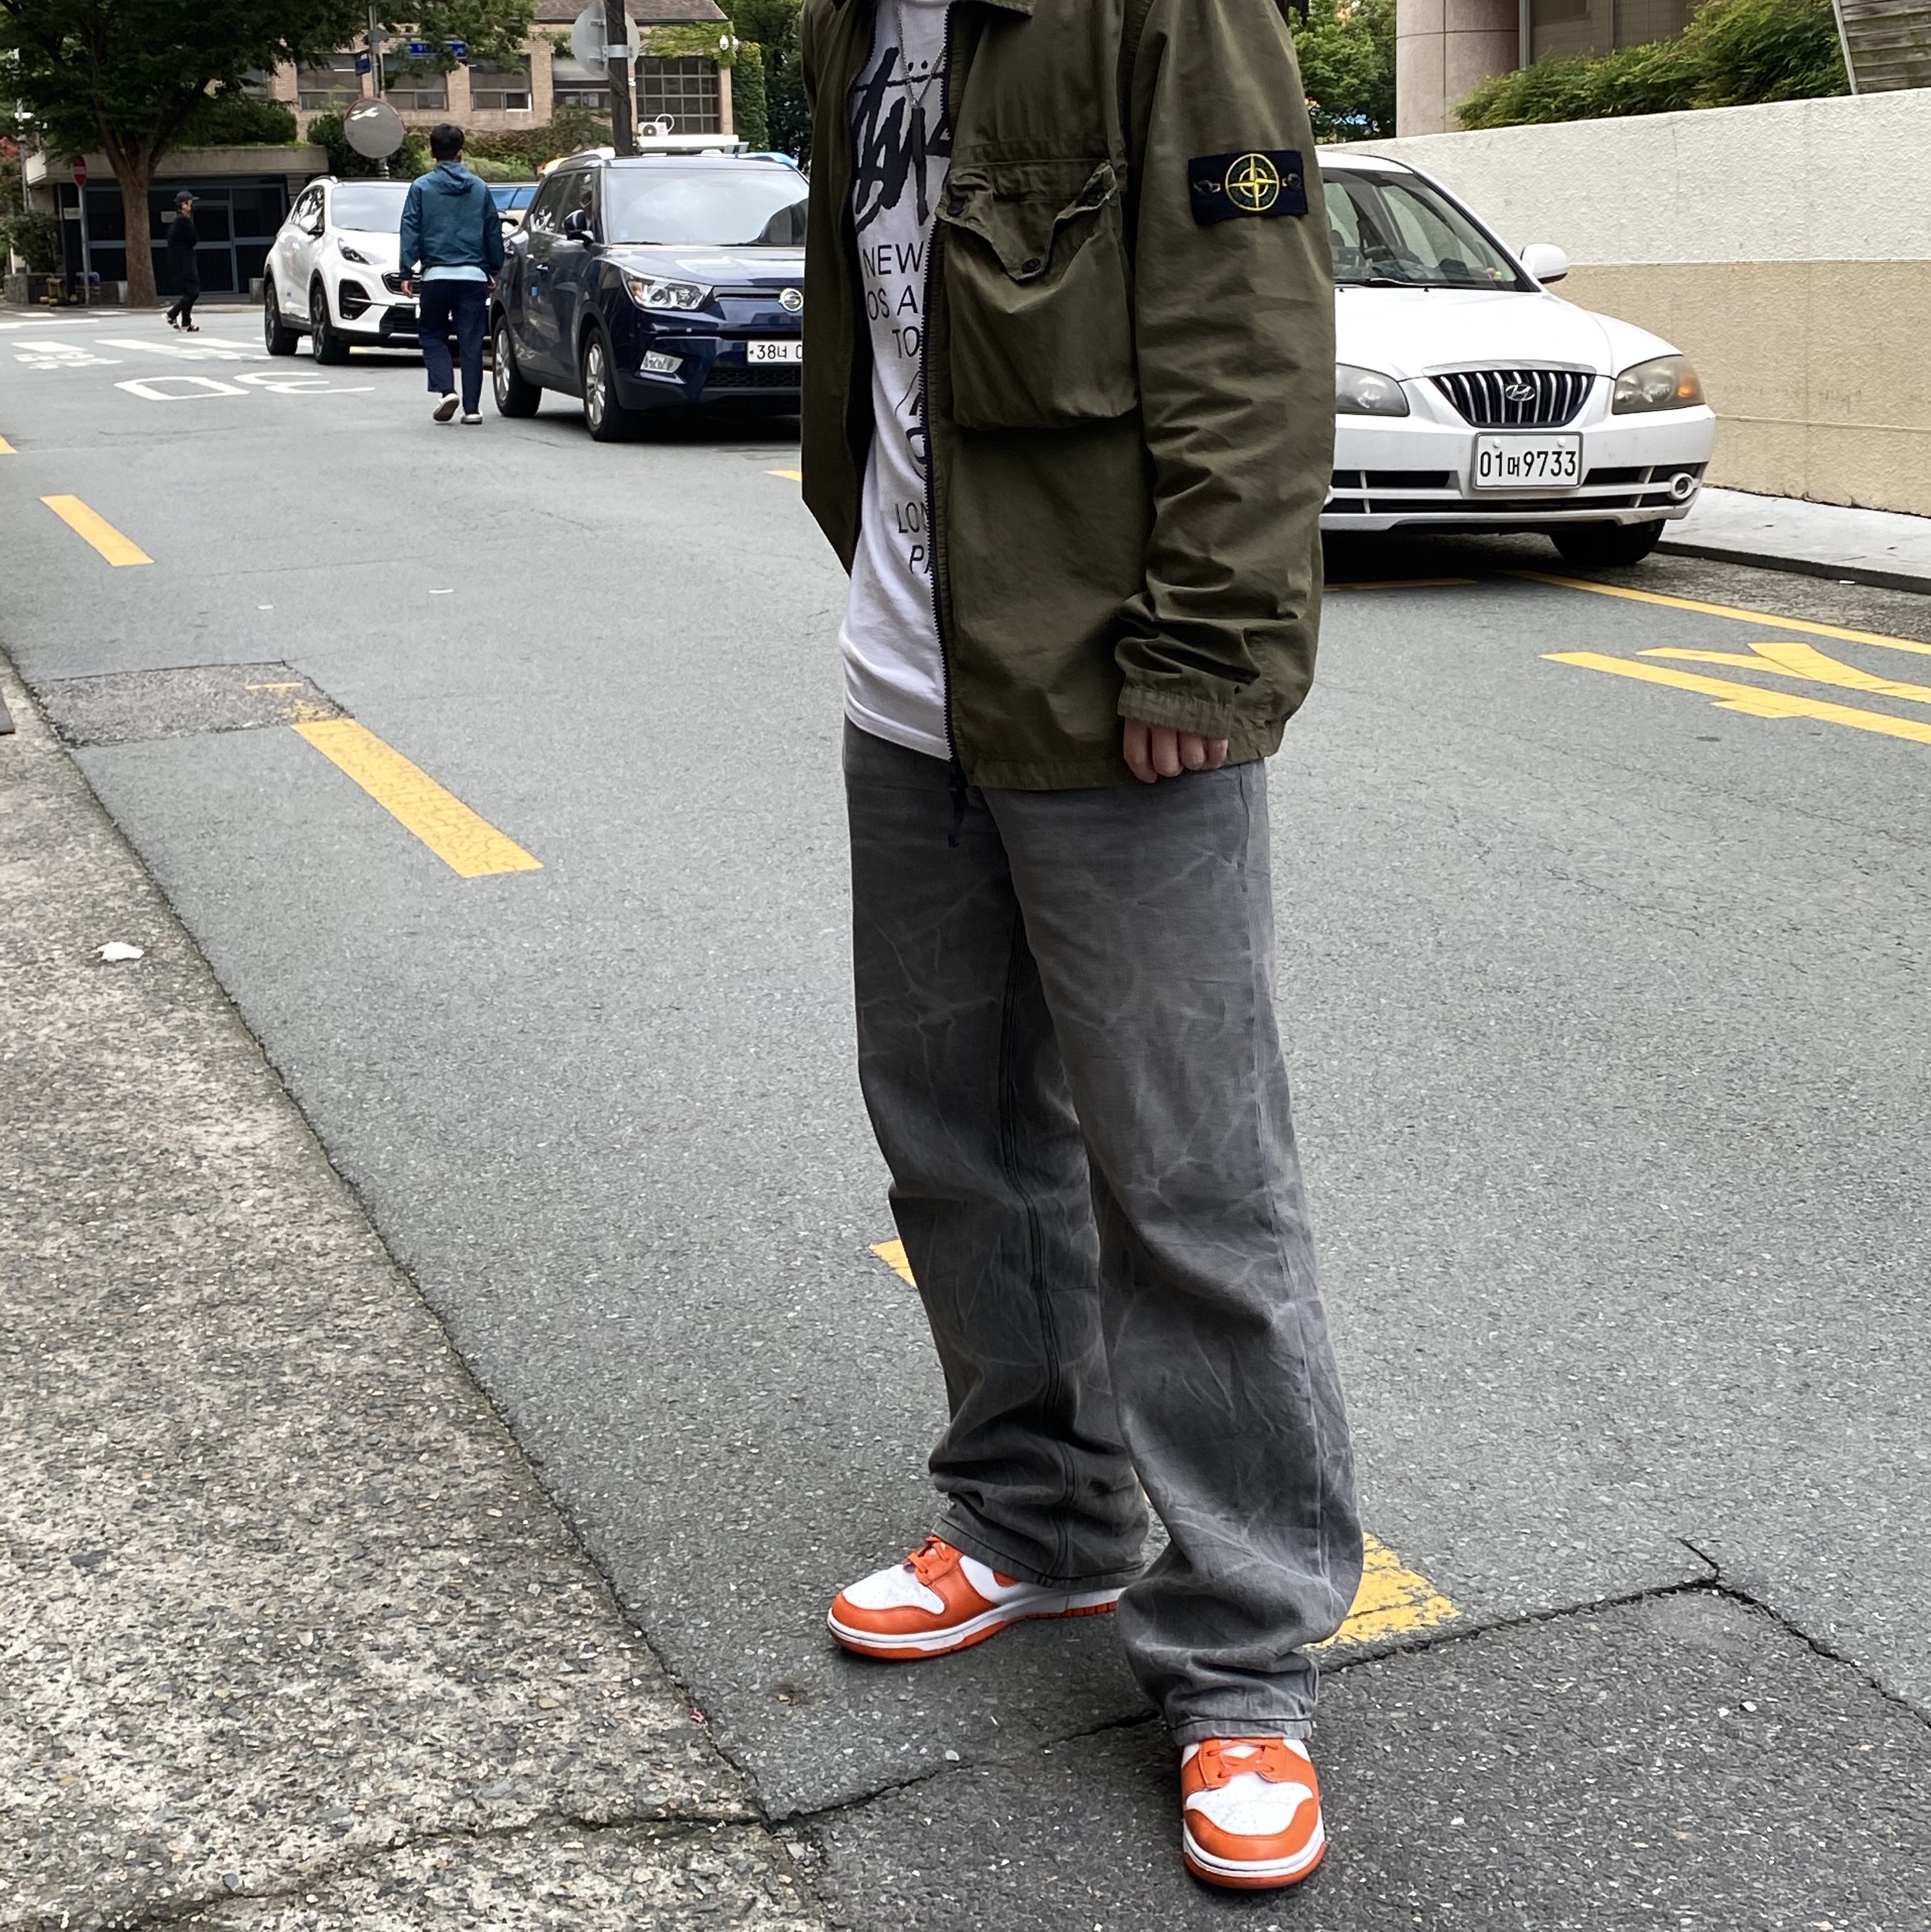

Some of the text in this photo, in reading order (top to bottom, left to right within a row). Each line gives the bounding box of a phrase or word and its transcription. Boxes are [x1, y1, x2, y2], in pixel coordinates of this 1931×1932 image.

[863, 241, 925, 278] NEW
[867, 285, 919, 321] OS A
[891, 326, 920, 358] TO
[1480, 451, 1577, 477] 01머9733
